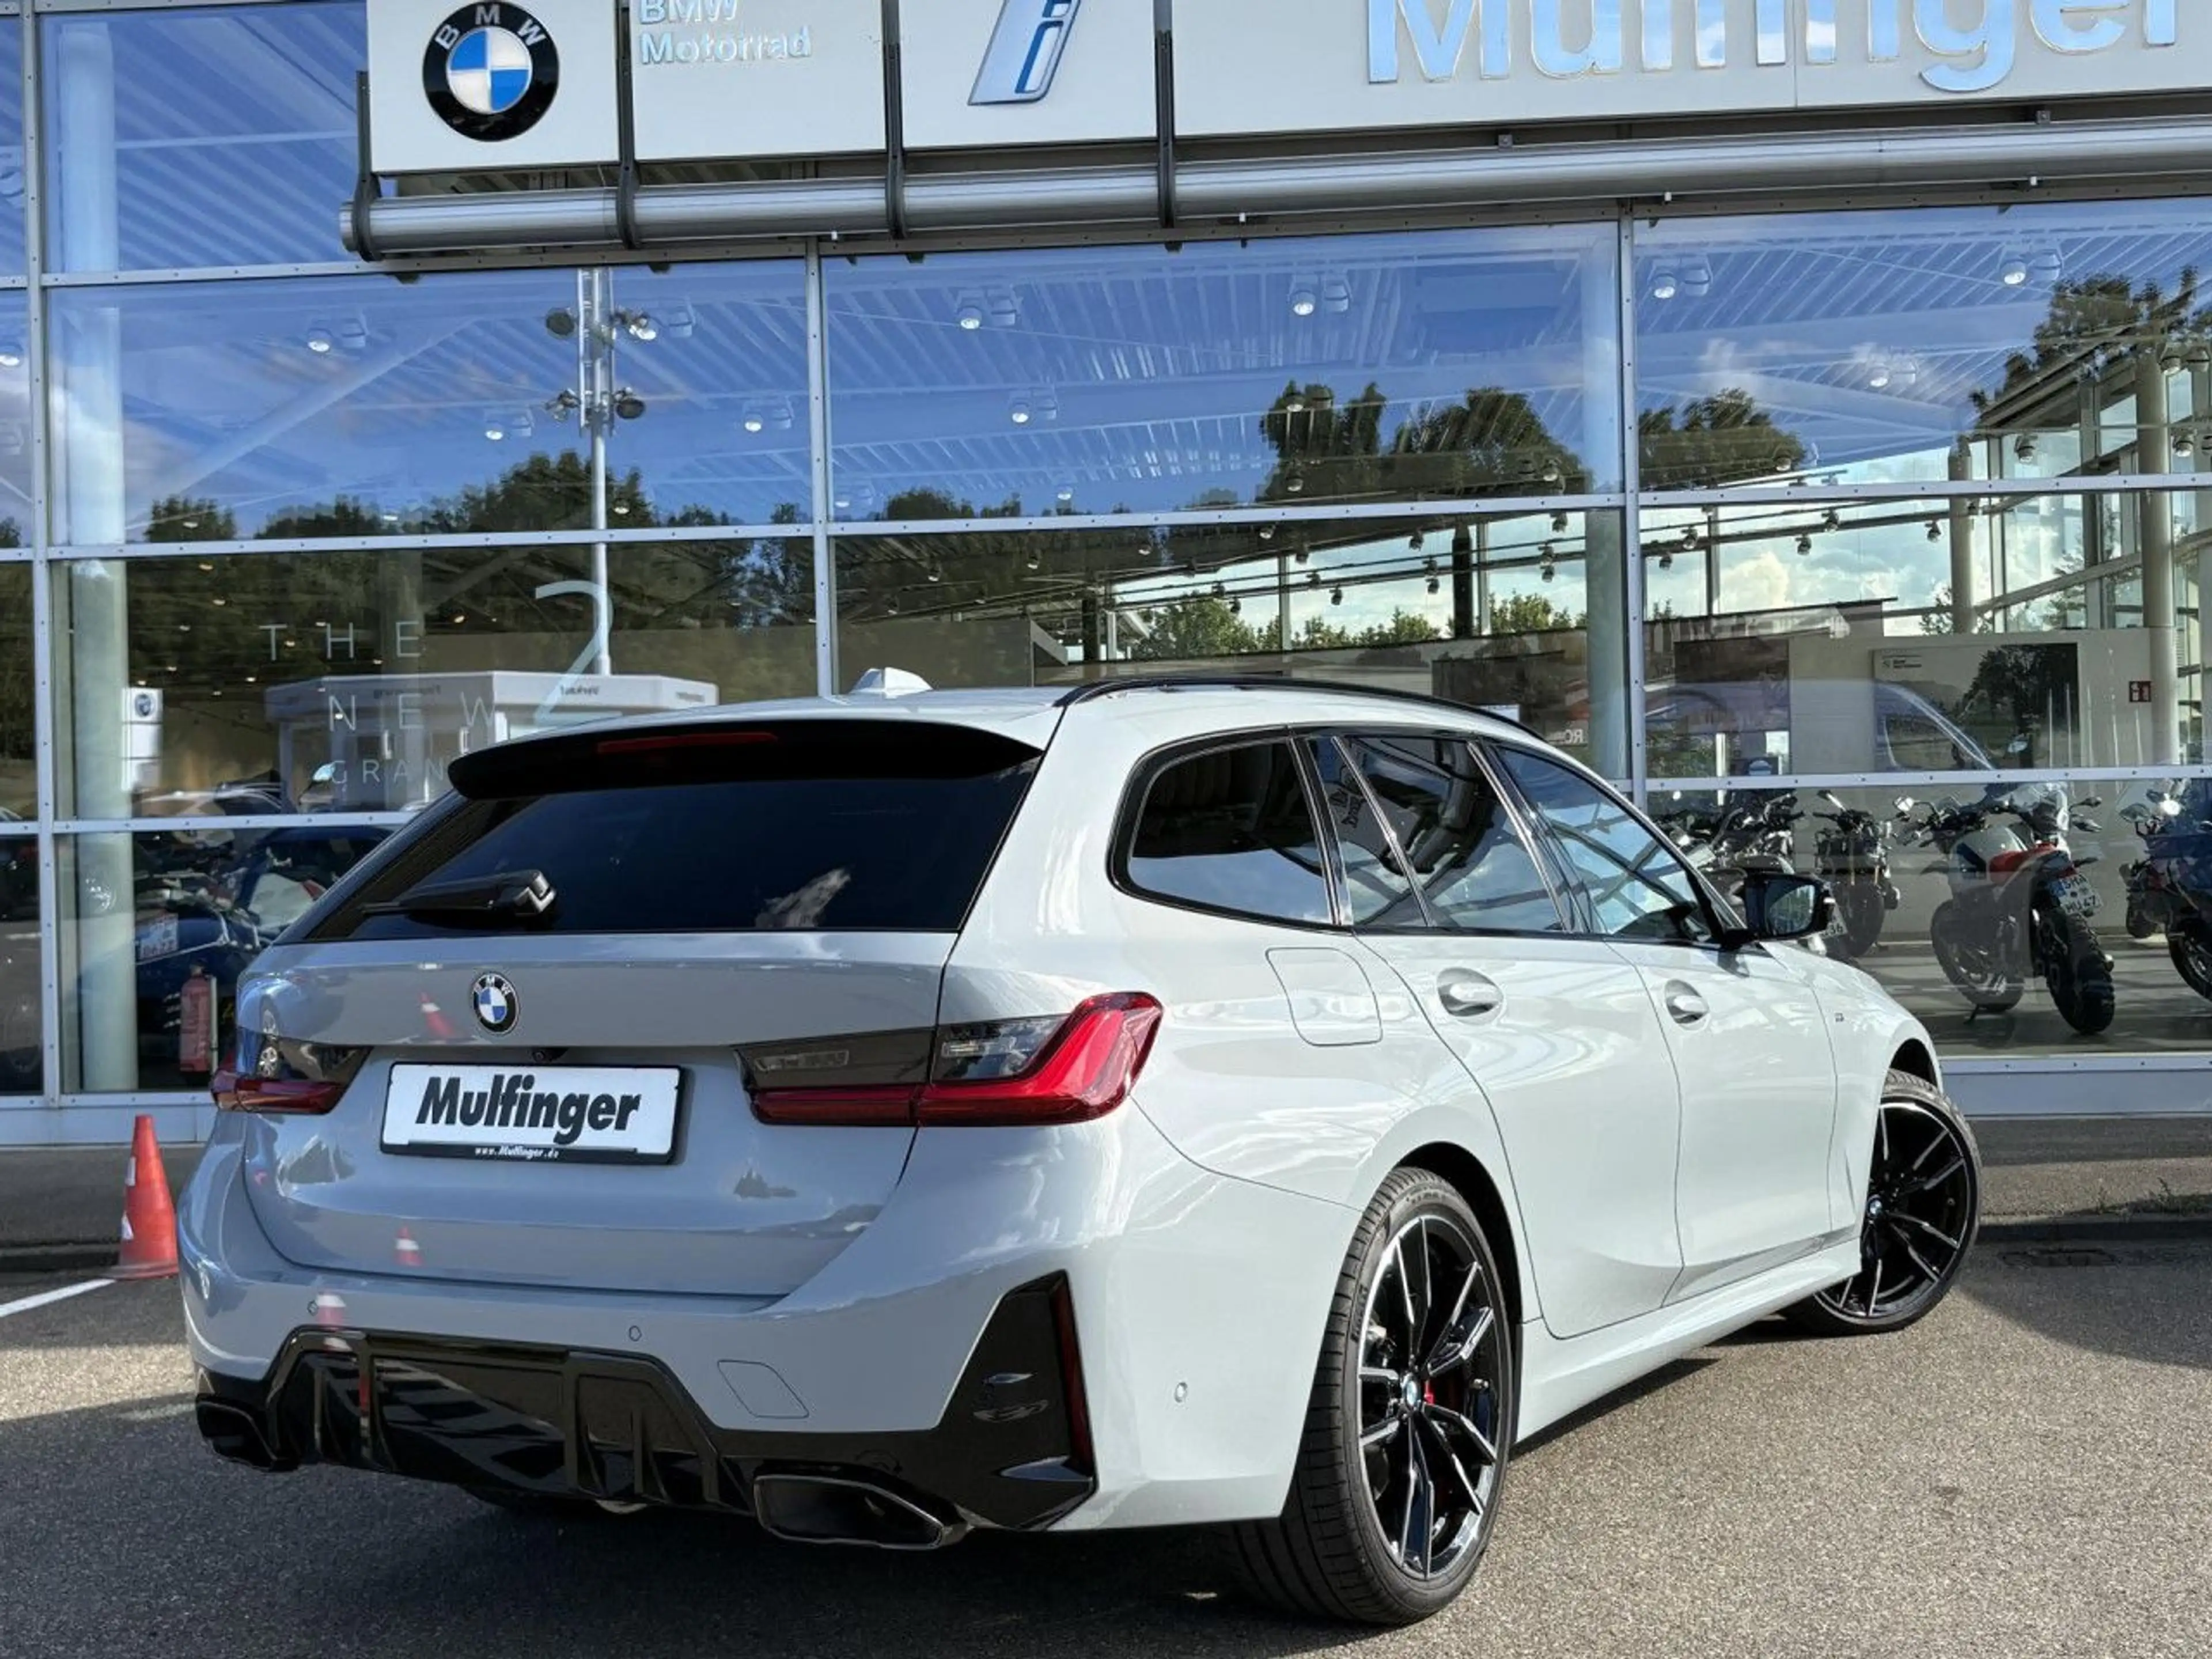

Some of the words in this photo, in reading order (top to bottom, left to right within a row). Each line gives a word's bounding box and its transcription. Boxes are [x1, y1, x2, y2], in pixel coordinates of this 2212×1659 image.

[435, 5, 547, 50] BMW
[639, 0, 737, 24] BMW
[640, 24, 812, 64] Motorrad
[259, 621, 421, 661] THE
[328, 691, 496, 732] NEW
[473, 975, 513, 995] BMW
[415, 1074, 642, 1145] Mulfinger
